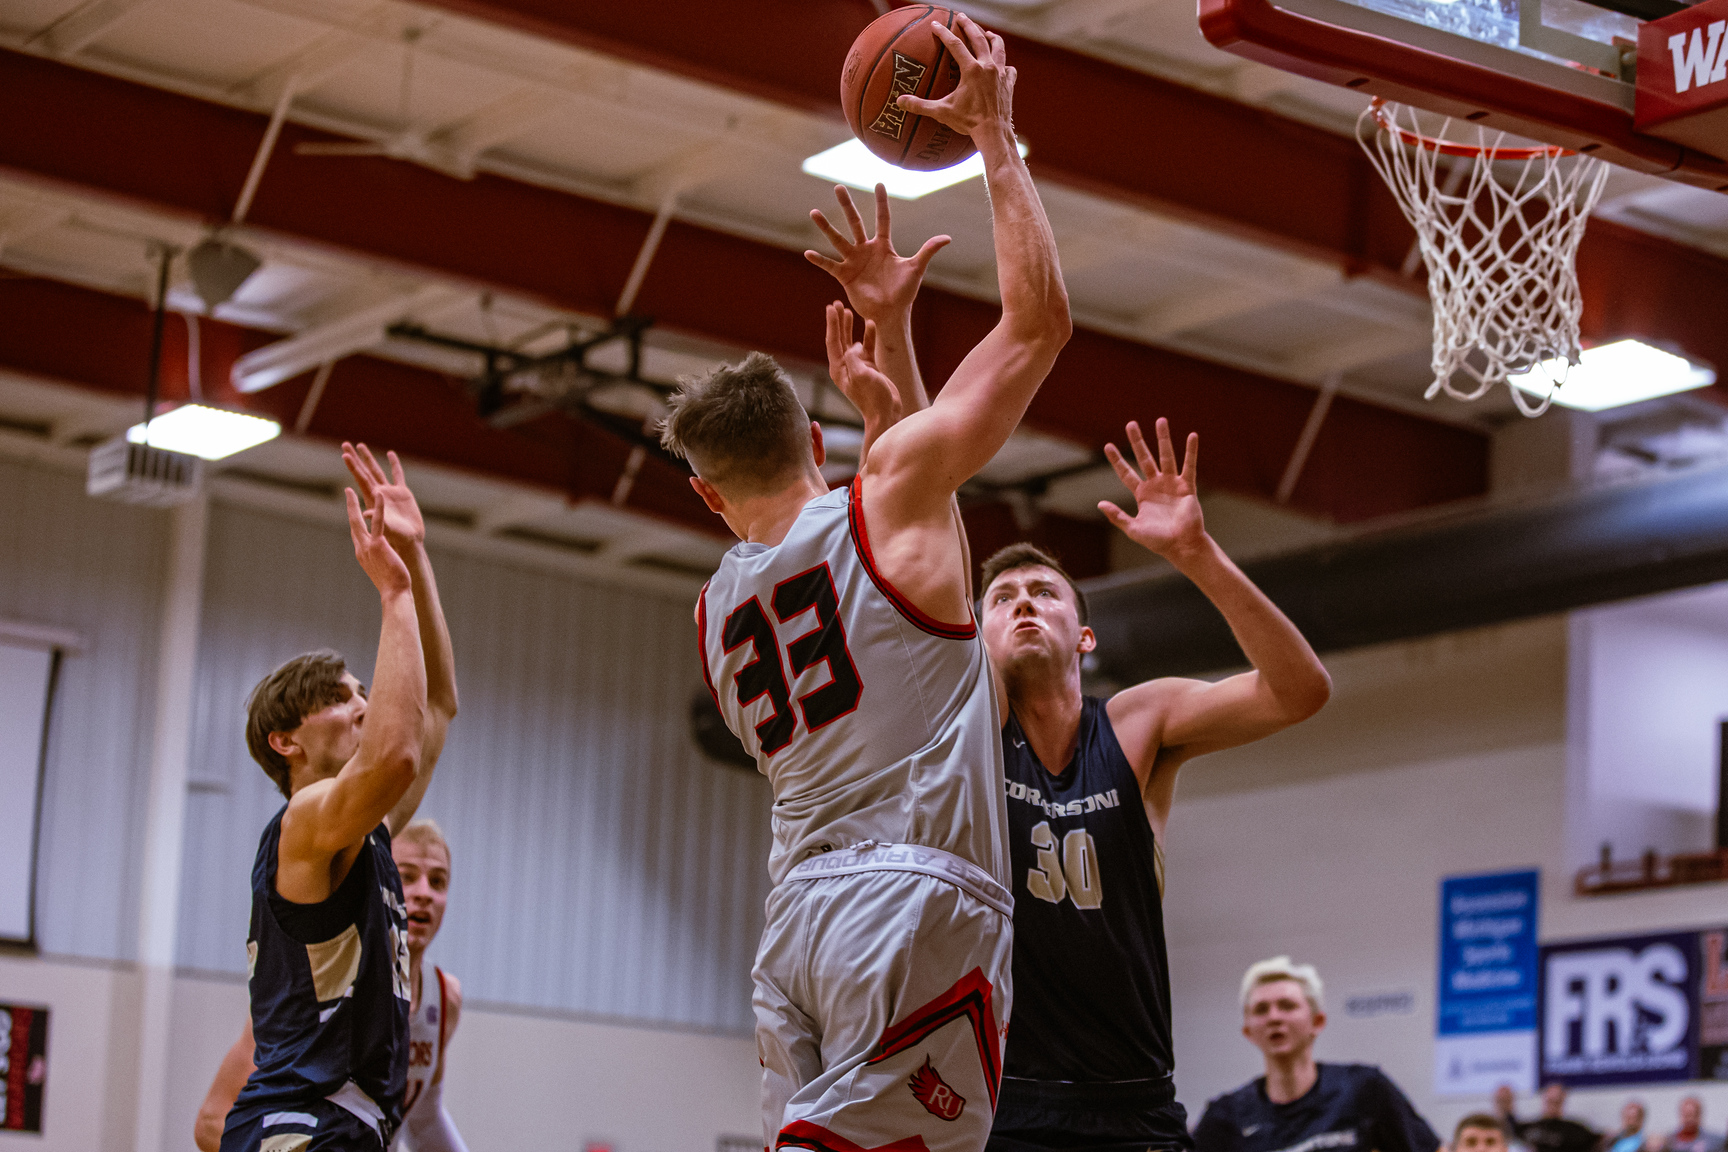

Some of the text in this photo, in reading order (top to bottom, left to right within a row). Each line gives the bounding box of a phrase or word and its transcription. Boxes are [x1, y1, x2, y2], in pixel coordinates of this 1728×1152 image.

[722, 560, 864, 758] 33
[1027, 820, 1103, 910] 30
[928, 1083, 964, 1118] RU
